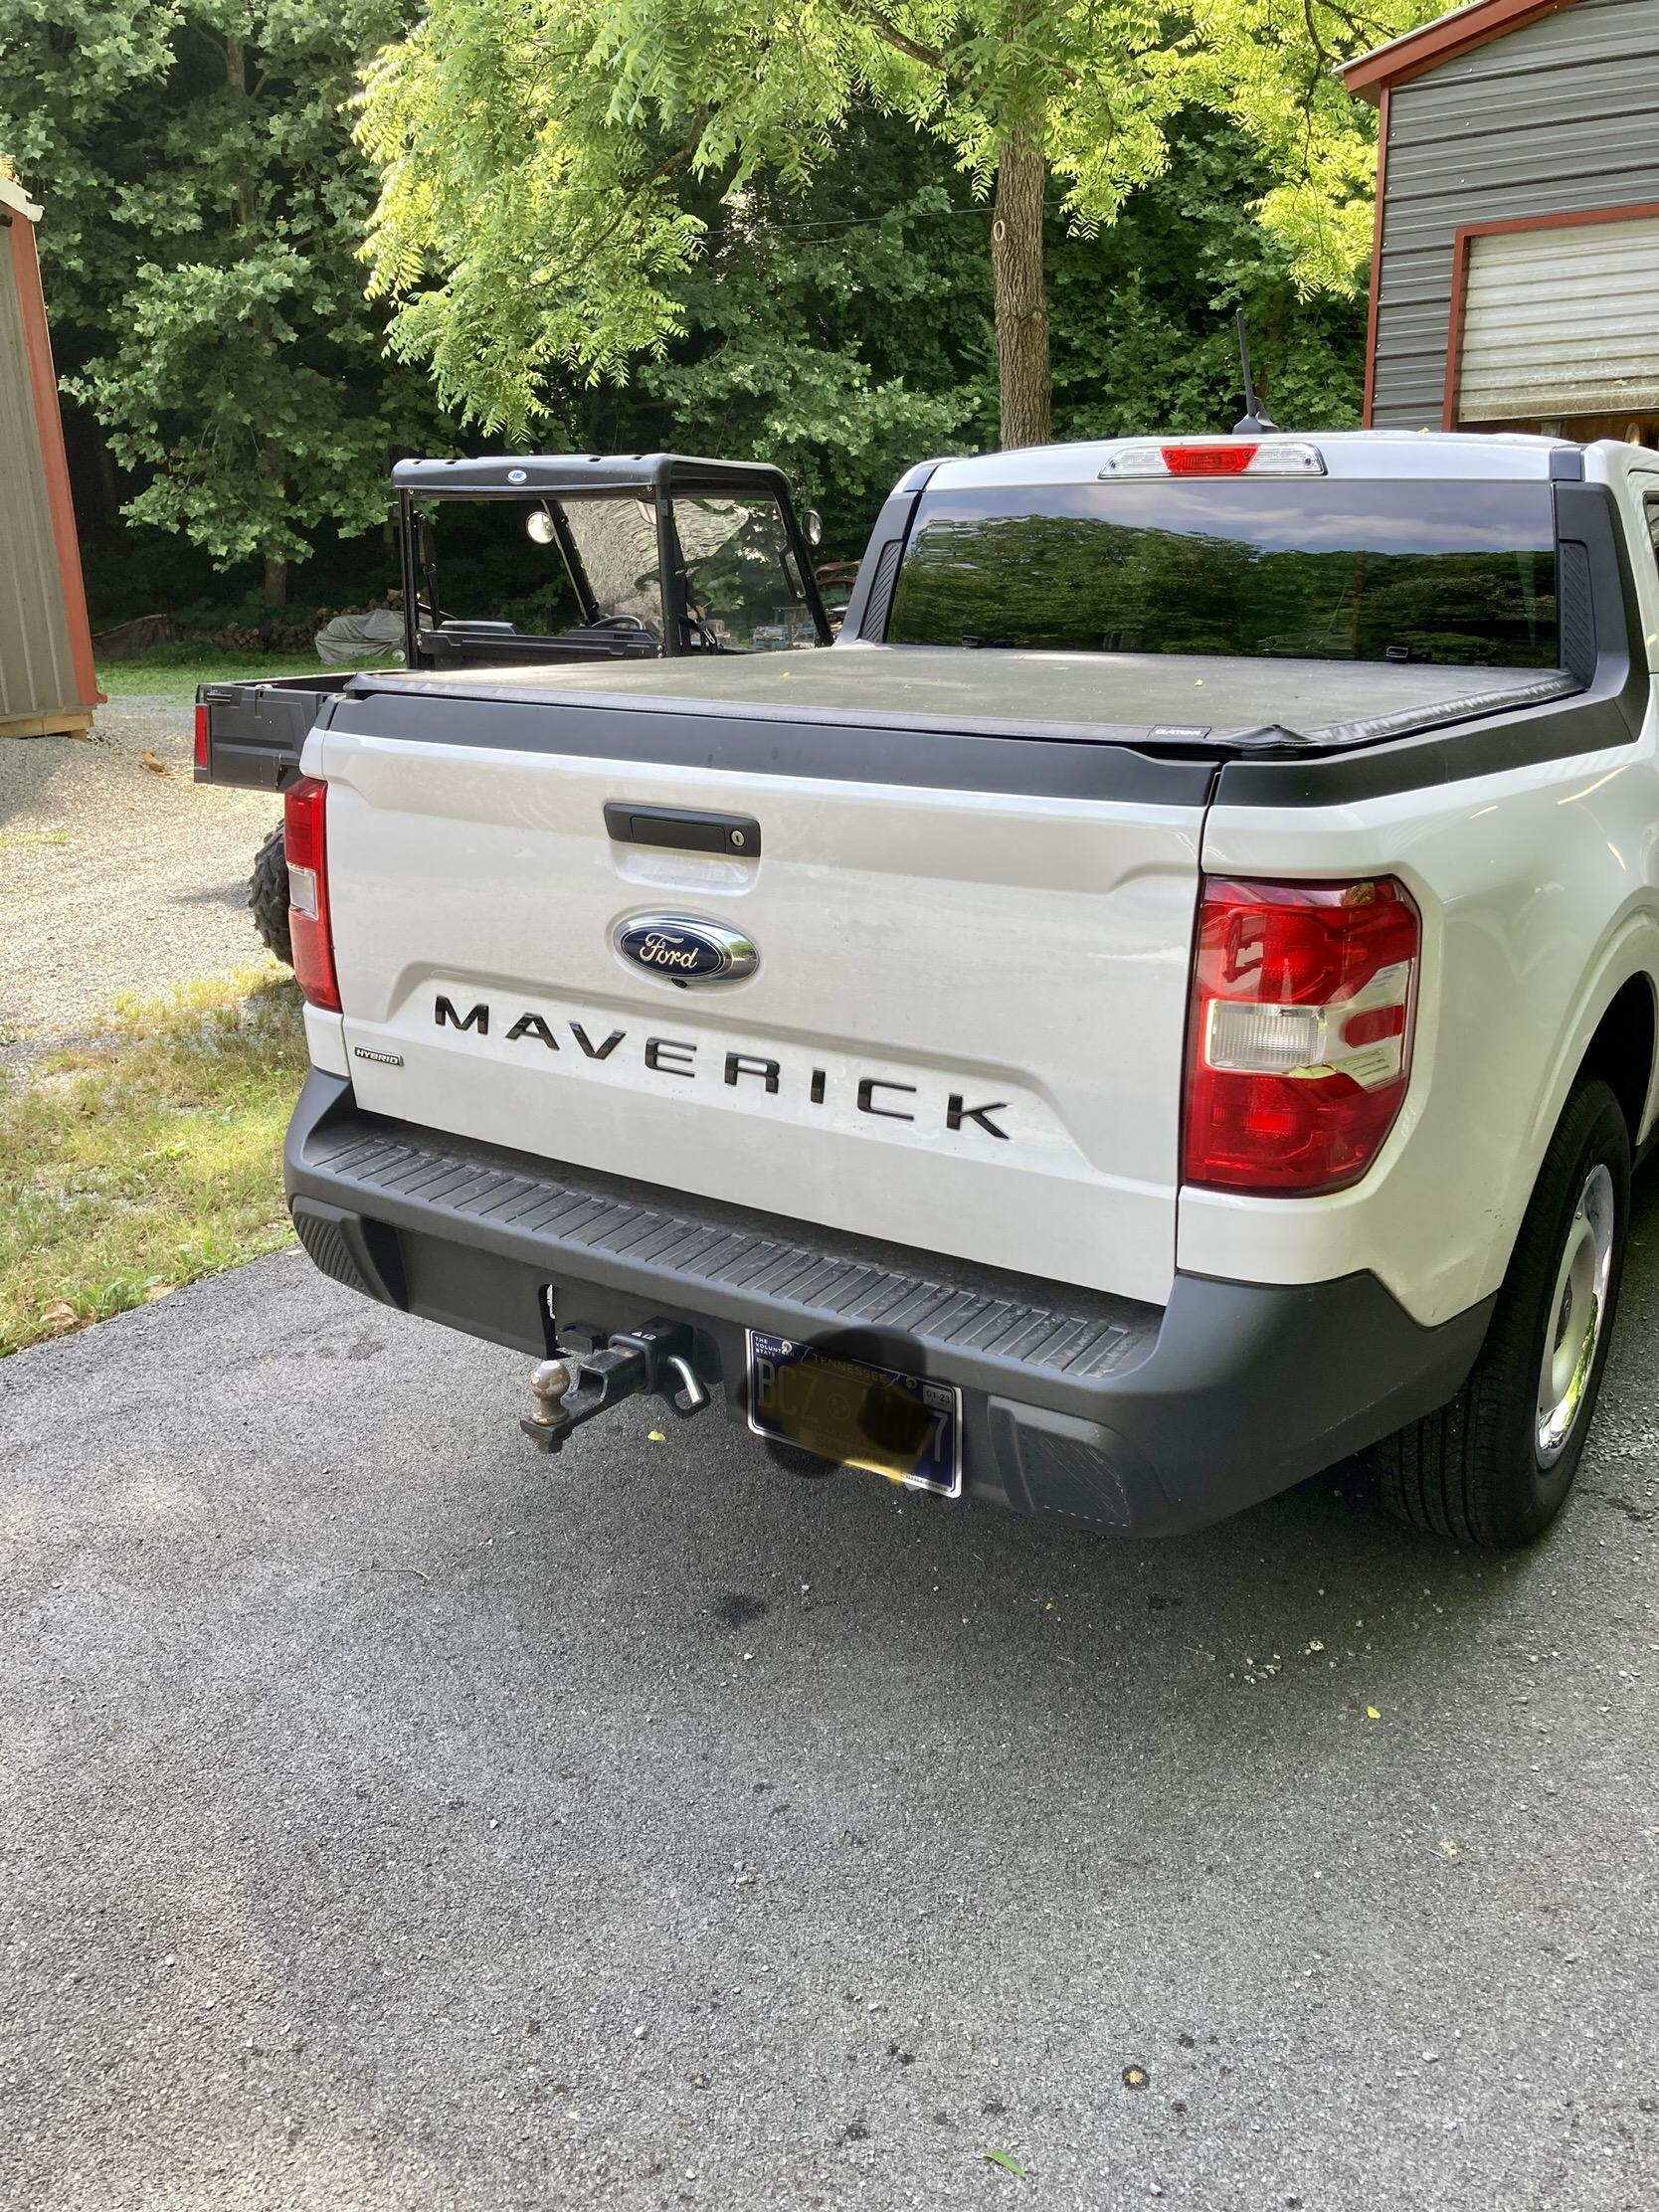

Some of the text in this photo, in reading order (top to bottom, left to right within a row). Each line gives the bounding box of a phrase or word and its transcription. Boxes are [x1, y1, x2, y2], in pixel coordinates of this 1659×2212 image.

[640, 932, 699, 970] Ford
[356, 1048, 399, 1065] HYBRID
[434, 994, 1011, 1141] MAVERICK
[755, 1343, 795, 1357] VOLUNT
